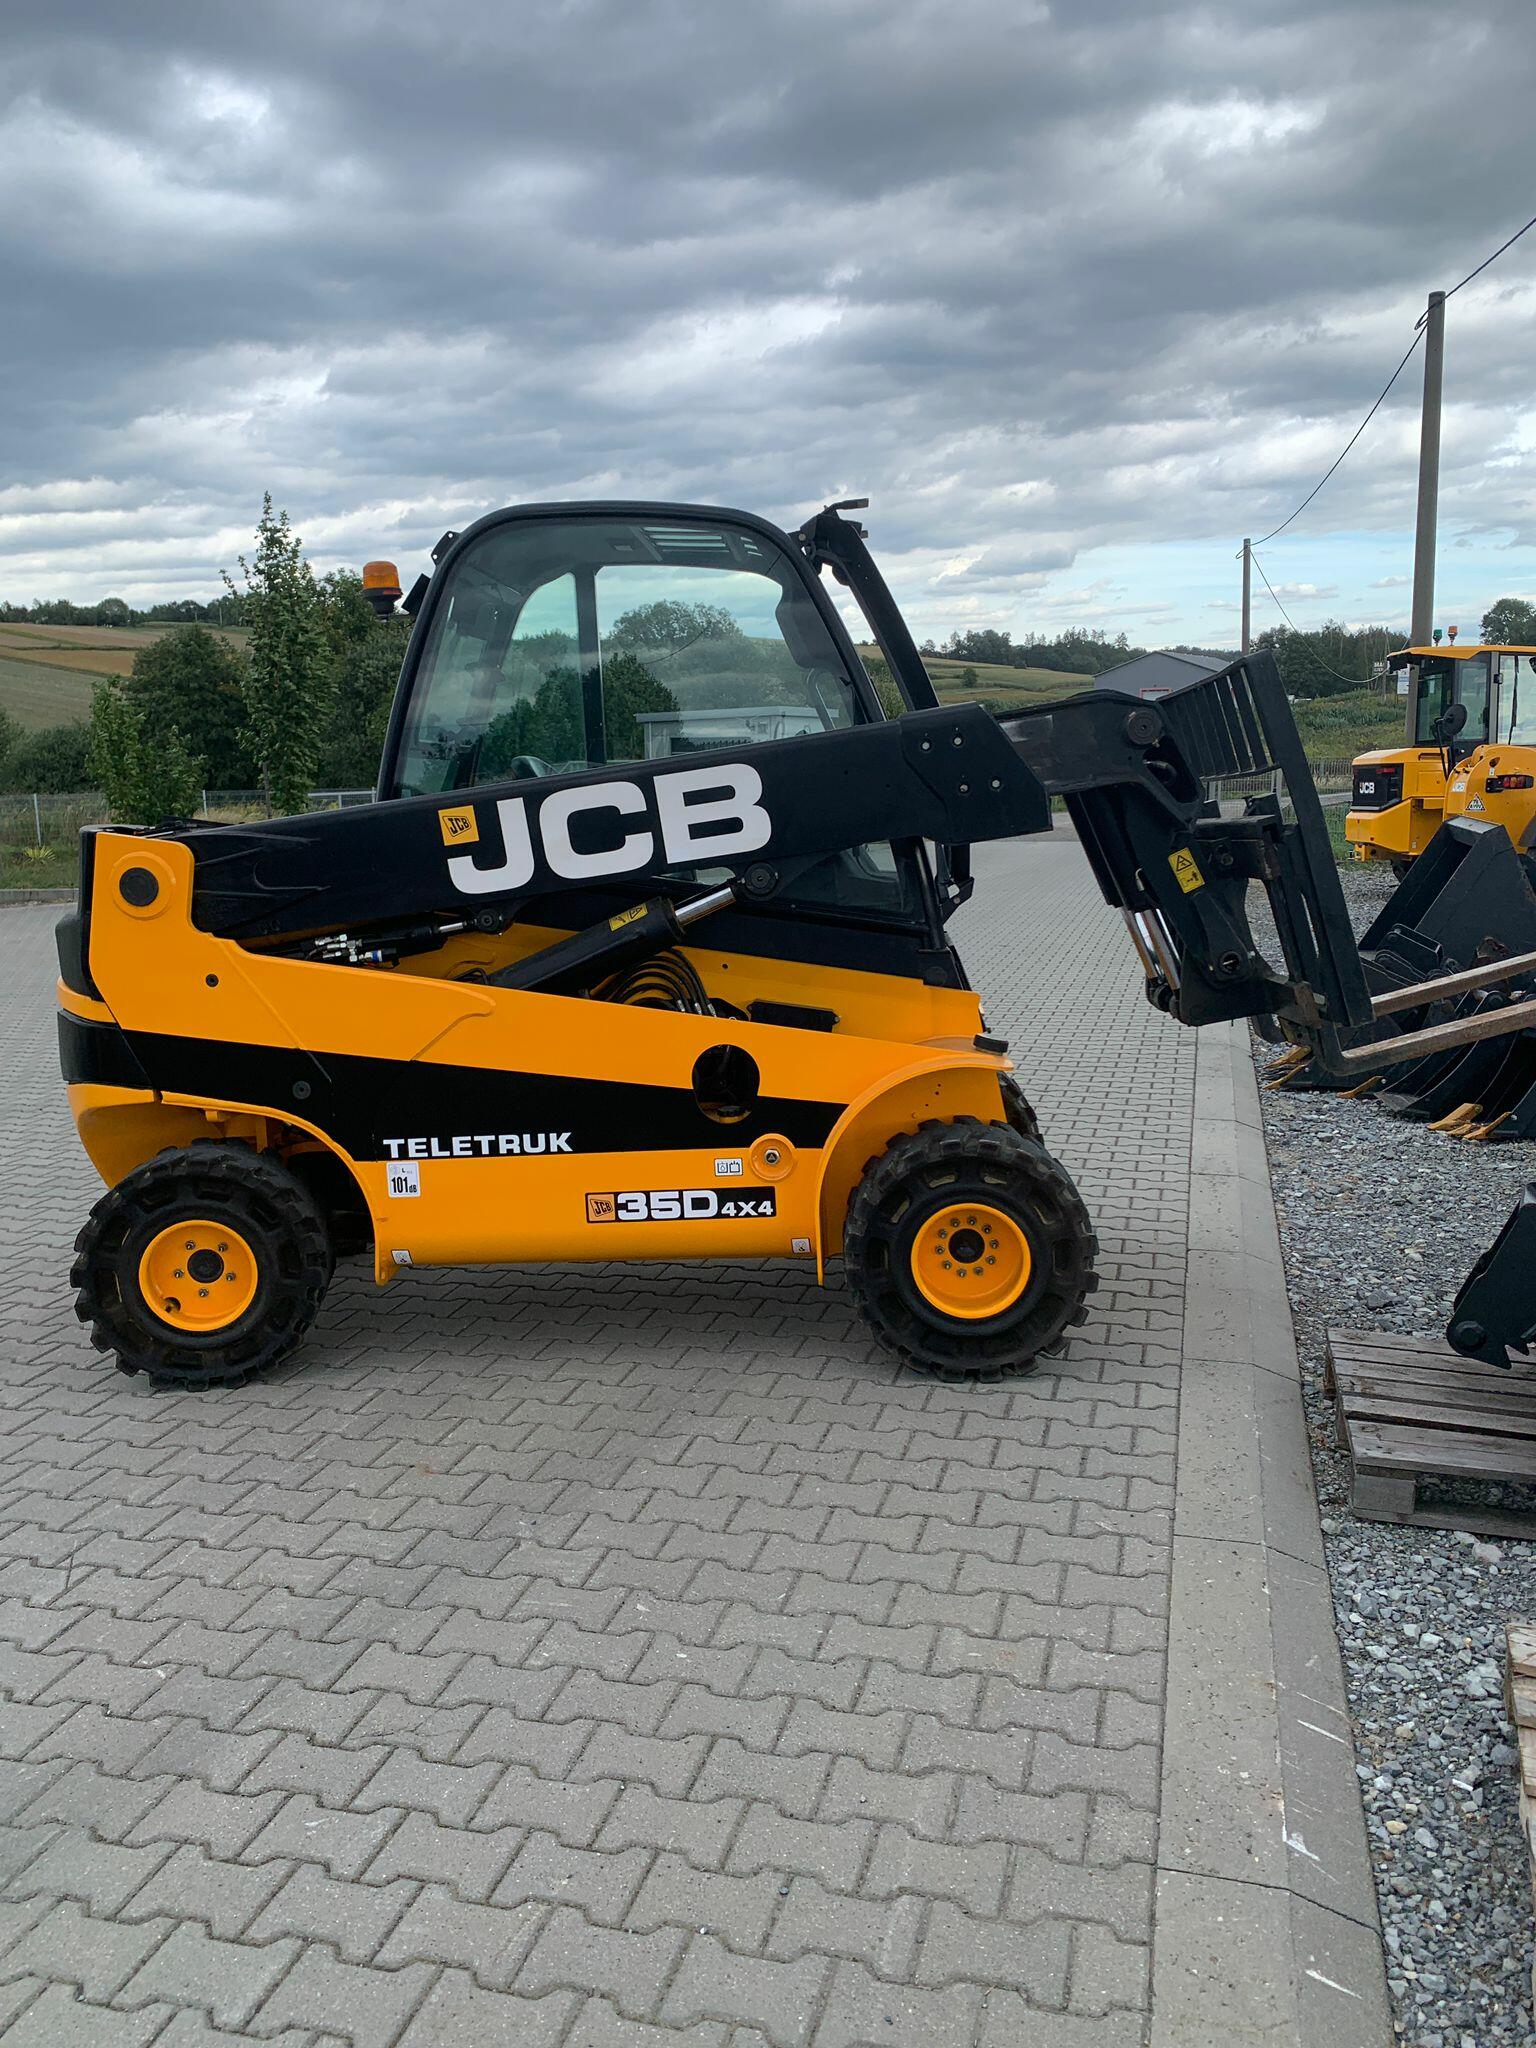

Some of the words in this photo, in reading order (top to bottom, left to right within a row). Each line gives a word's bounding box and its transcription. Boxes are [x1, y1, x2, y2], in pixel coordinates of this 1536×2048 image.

[1359, 781, 1375, 794] JCB
[447, 817, 471, 835] JCB
[447, 763, 772, 895] JCB
[383, 1132, 574, 1159] TELETRUK
[391, 1176, 408, 1194] 101
[594, 1200, 613, 1216] JCB
[617, 1189, 719, 1221] 35D
